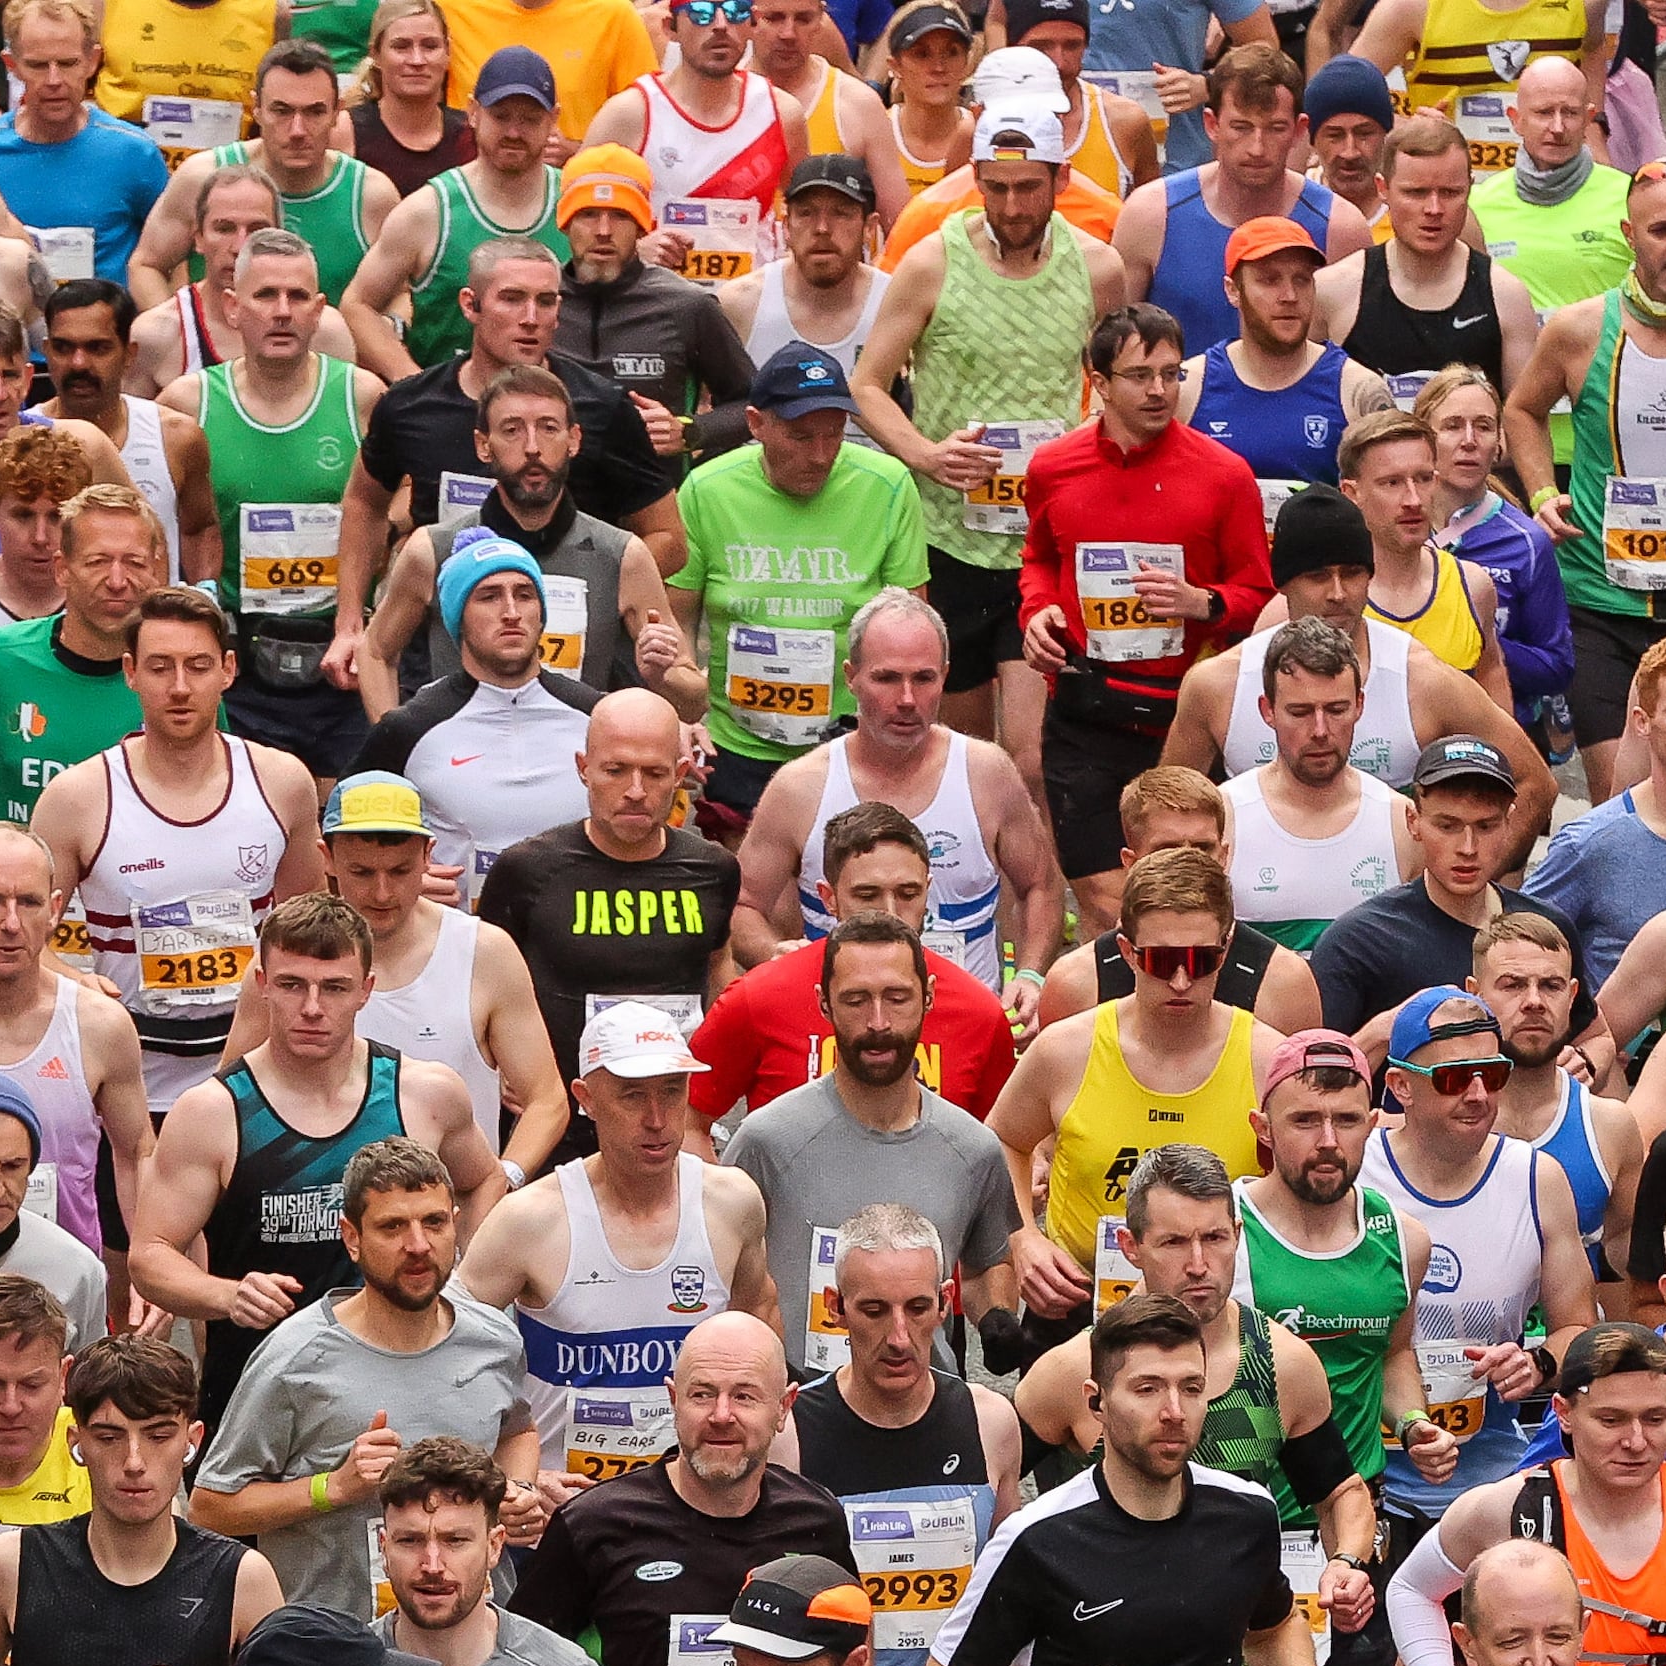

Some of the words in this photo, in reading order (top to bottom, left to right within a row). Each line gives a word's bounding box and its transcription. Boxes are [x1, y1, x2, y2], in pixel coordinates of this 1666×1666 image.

[267, 560, 324, 586] 669
[740, 681, 815, 713] 3295
[572, 889, 704, 936] JASPER
[156, 952, 239, 986] 2183
[635, 1031, 675, 1043] HOKA
[807, 1035, 819, 1081] THE
[261, 1193, 322, 1216] FINISHER
[1305, 1313, 1390, 1332] Beechmount
[574, 1432, 607, 1448] BIG
[617, 1436, 655, 1448] EARS
[867, 1518, 890, 1533] Irish
[891, 1520, 908, 1534] Life
[921, 1516, 965, 1531] DUBLIN
[888, 1553, 915, 1563] JAMES
[865, 1573, 959, 1606] 2993
[897, 1635, 925, 1647] 2993
